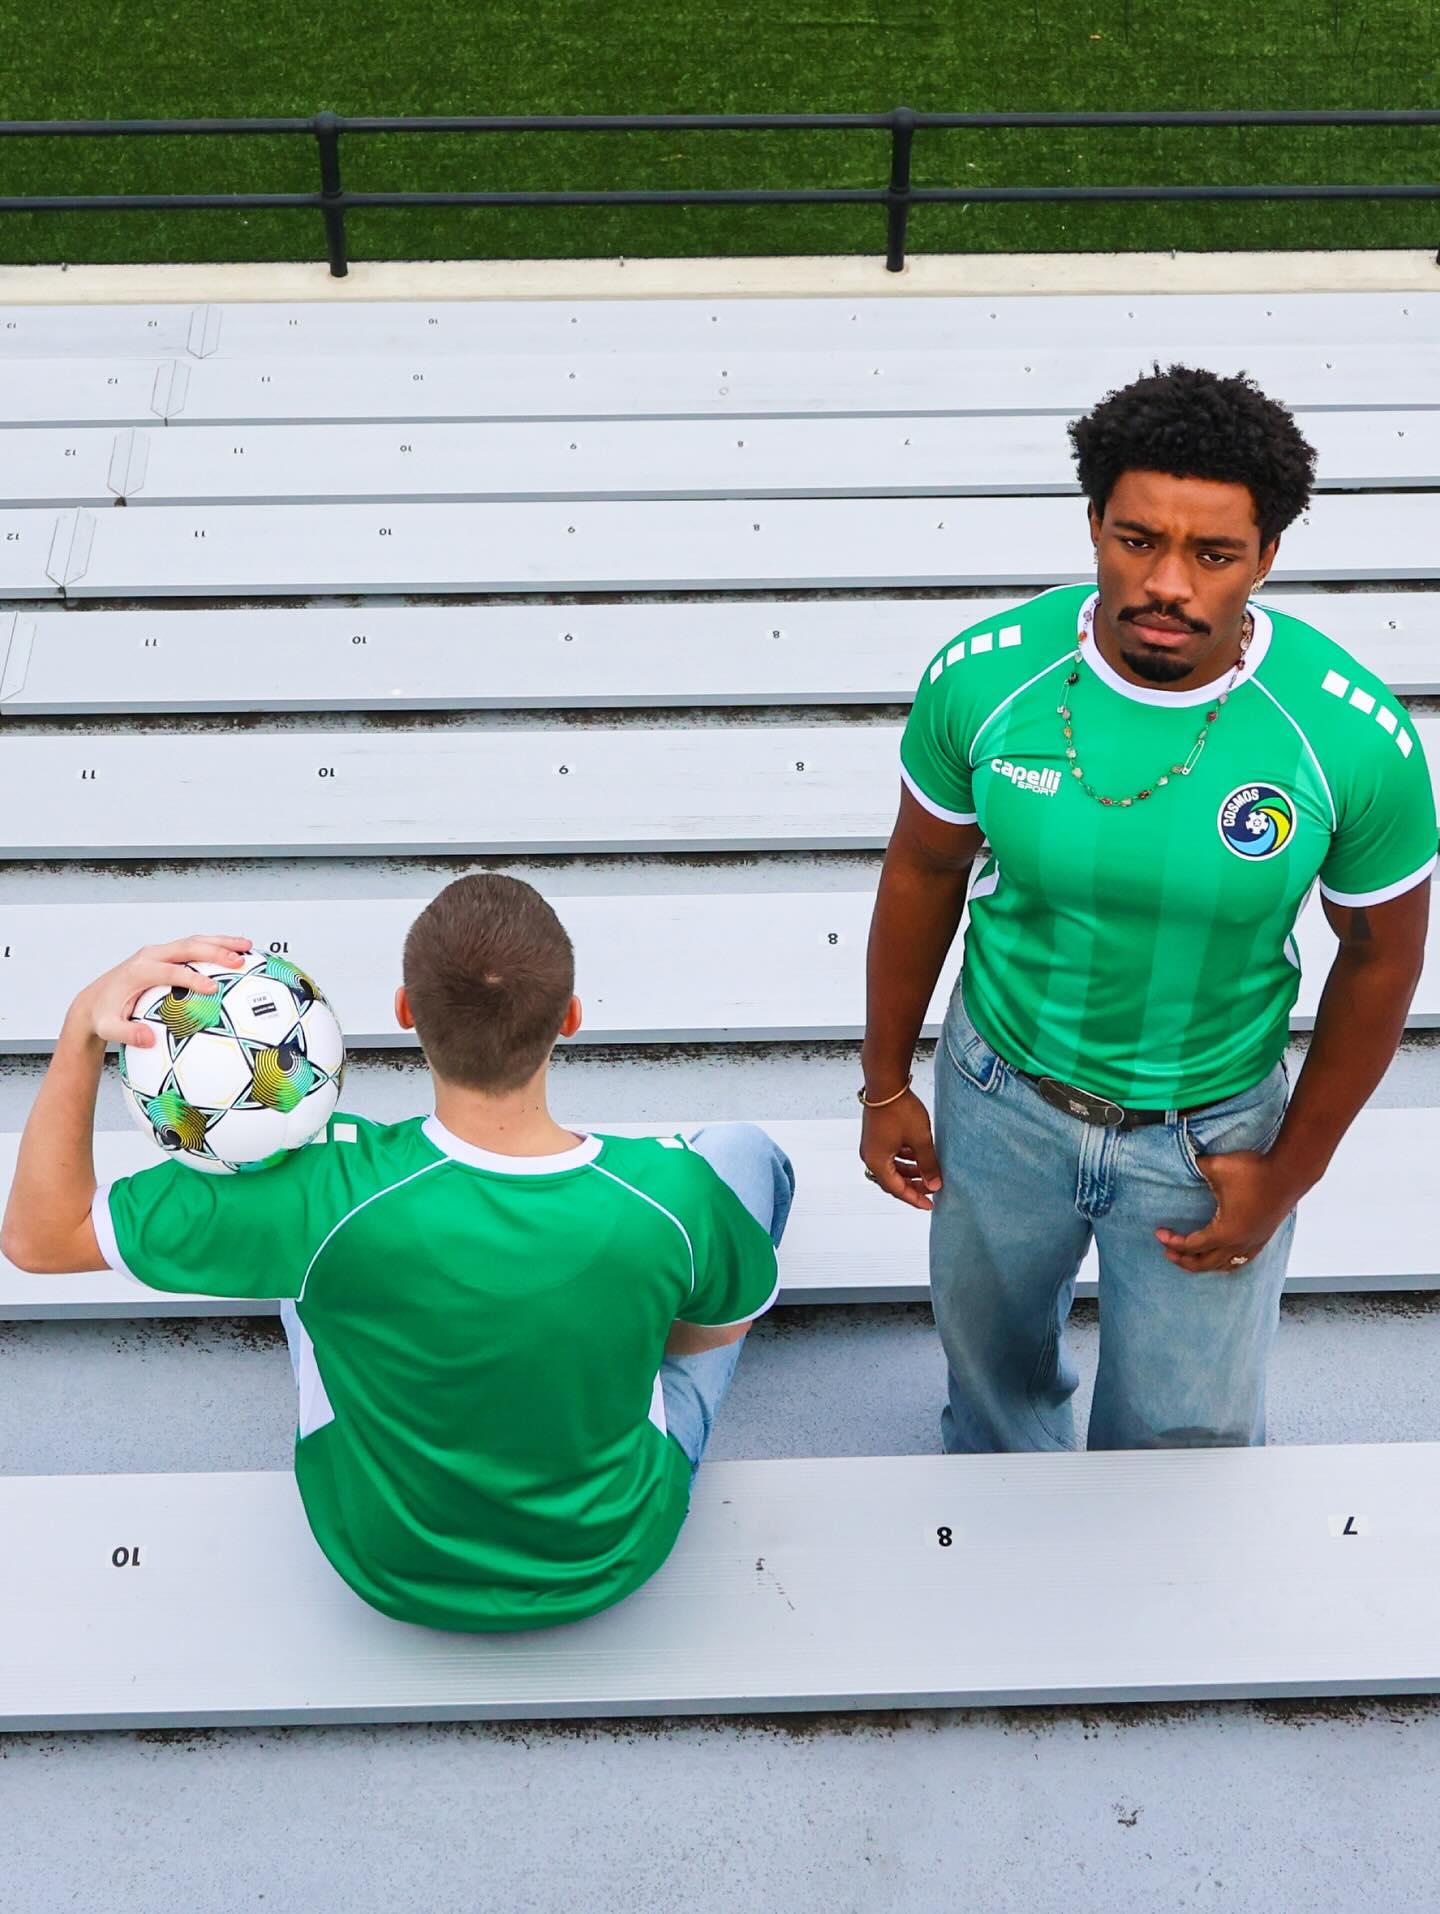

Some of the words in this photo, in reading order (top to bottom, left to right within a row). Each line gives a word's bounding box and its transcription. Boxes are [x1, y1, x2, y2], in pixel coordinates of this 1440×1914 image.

[64, 449, 76, 457] 12
[399, 445, 412, 453] 10
[1302, 518, 1310, 526] 5
[378, 528, 392, 536] 10
[567, 526, 576, 534] 9
[753, 523, 761, 532] 8
[6, 533, 20, 541] 12
[194, 530, 205, 538] 11
[1388, 621, 1397, 630] 5
[564, 633, 574, 642] 9
[772, 630, 780, 639] 8
[145, 638, 157, 647] 11
[351, 636, 367, 645] 10
[558, 765, 569, 775] 9
[795, 761, 805, 772] 8
[81, 769, 96, 780] 11
[318, 767, 335, 778] 10
[991, 758, 1062, 793] capelli
[1017, 781, 1057, 797] SPORT
[1222, 788, 1260, 827] COSMOS
[828, 933, 838, 944] 8
[270, 942, 288, 953] 10
[1343, 1517, 1357, 1535] 7
[937, 1527, 952, 1546] 8
[112, 1547, 140, 1567] 10
